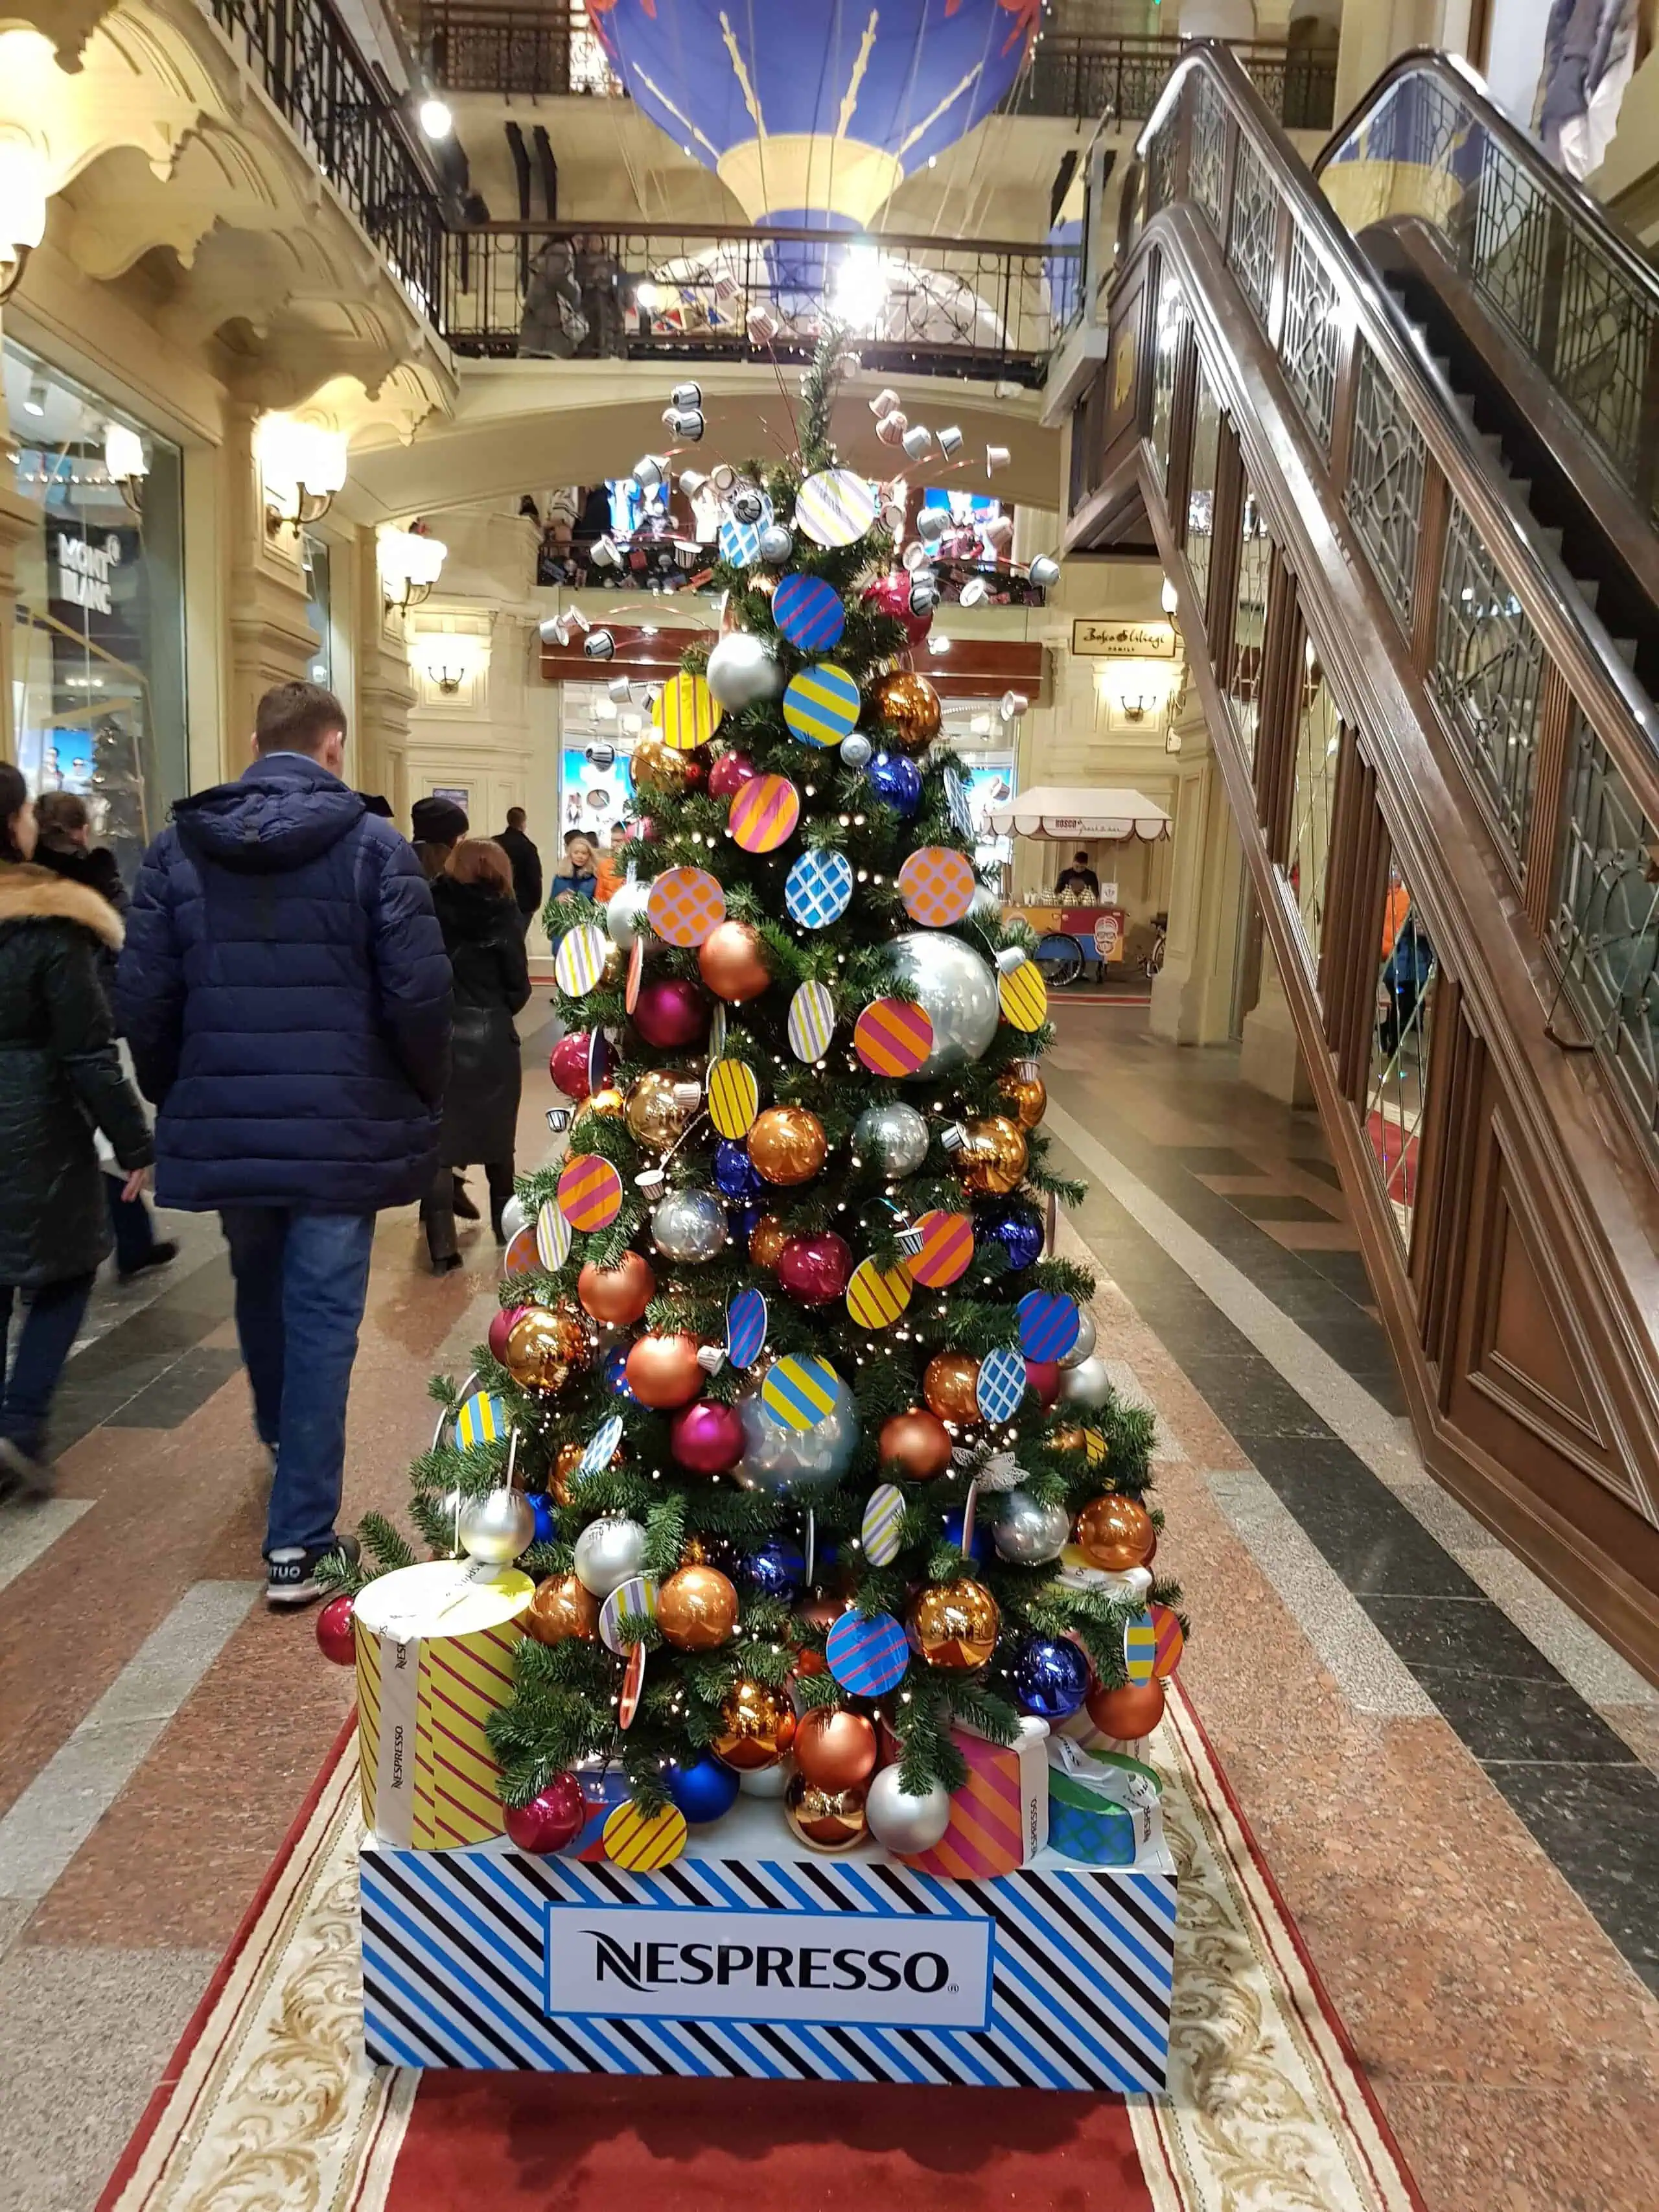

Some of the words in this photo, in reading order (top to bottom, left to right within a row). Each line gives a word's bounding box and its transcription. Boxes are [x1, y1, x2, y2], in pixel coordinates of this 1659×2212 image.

[59, 533, 109, 583] MONT
[391, 1725, 404, 1789] NESPRESSO
[577, 1930, 949, 1993] NESPRESSO
